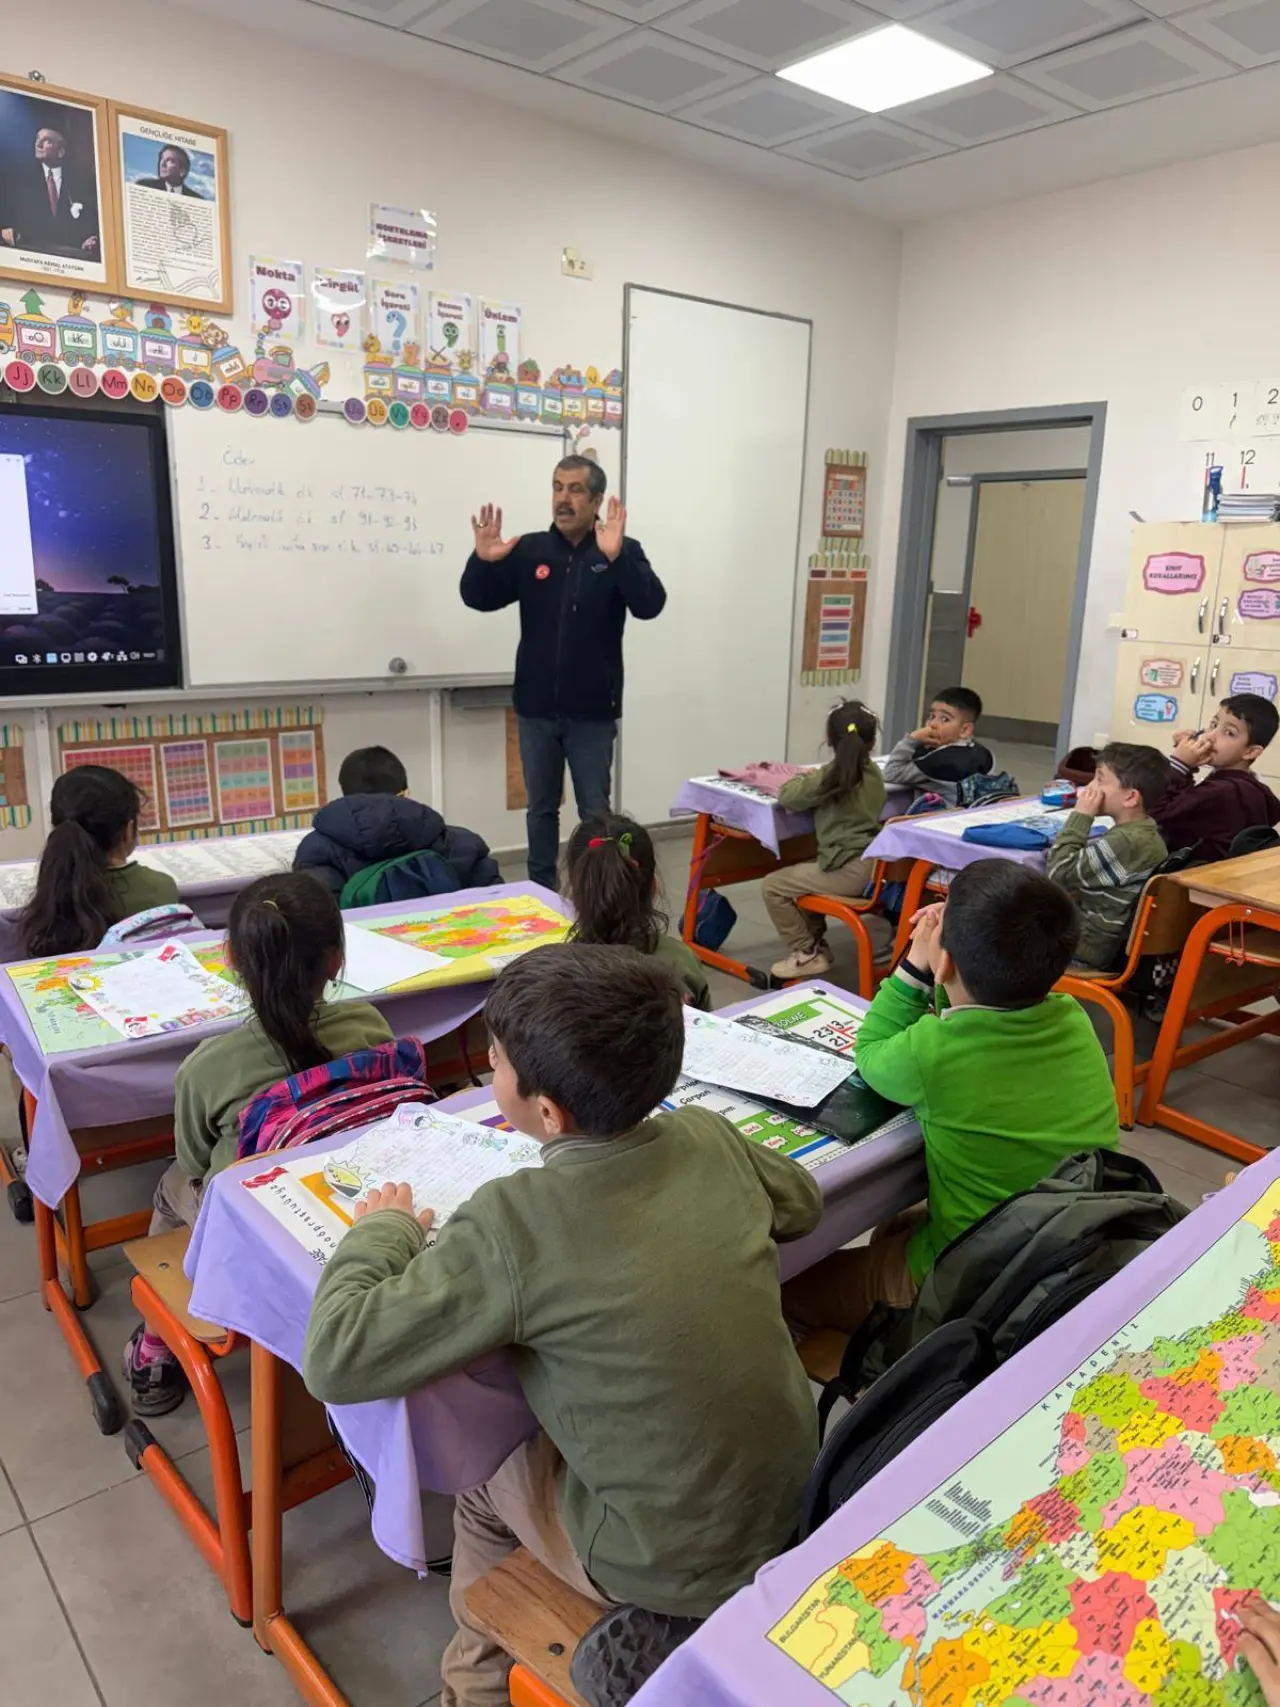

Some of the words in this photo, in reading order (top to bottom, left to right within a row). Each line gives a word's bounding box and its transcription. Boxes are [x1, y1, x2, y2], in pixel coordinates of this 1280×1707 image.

[256, 265, 296, 282] Nokta
[13, 366, 30, 386] Jj
[42, 369, 61, 386] Kk
[76, 373, 90, 388] Ll
[102, 378, 127, 391] Mm
[134, 379, 155, 393] Nn
[221, 387, 238, 407] Pp
[1192, 396, 1203, 411] 0
[1233, 392, 1238, 407] 1
[1267, 388, 1280, 405] 2
[1205, 452, 1216, 467] 11
[1240, 449, 1257, 465] 12
